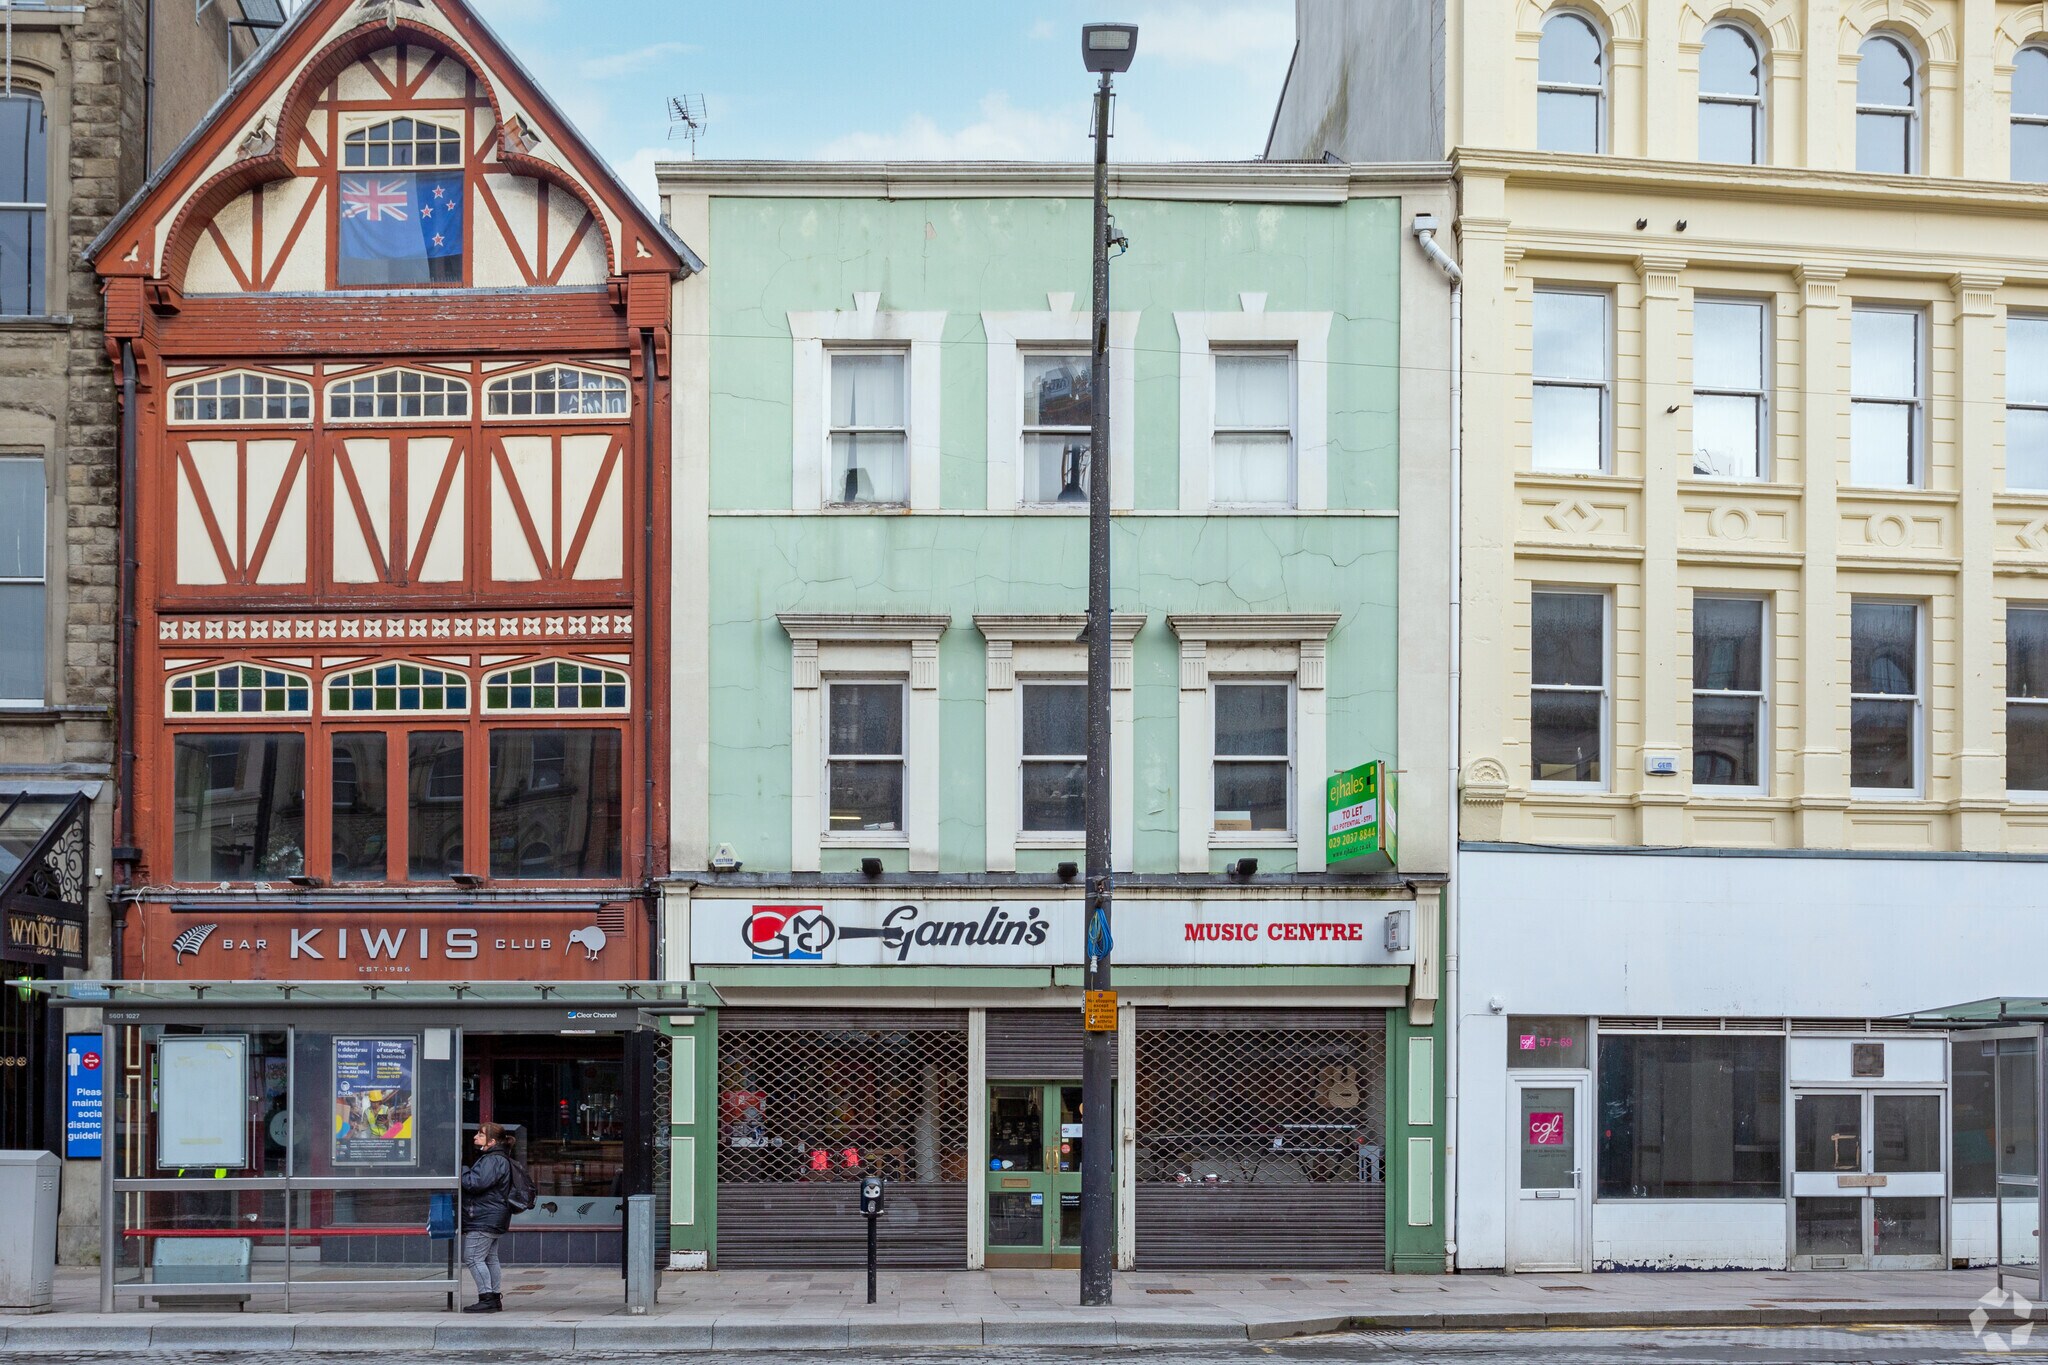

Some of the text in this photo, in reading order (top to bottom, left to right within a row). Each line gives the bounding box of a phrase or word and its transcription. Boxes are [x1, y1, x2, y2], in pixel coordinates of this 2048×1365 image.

[1330, 774, 1364, 806] ejhales
[1342, 805, 1363, 820] TO LET
[1339, 818, 1361, 830] POTENTIAL
[1328, 827, 1376, 849] 029 2037 8844
[10, 918, 80, 953] WYNDHAM
[882, 905, 1049, 961] Gamlin's
[1185, 923, 1363, 941] MUSIC CENTRE
[223, 928, 551, 960] BAR KIWIS CLUB
[1521, 1037, 1534, 1049] cgl
[76, 1088, 102, 1096] Pleas
[78, 1110, 103, 1118] socia
[68, 1121, 101, 1129] distanc
[1531, 1115, 1559, 1144] cgl
